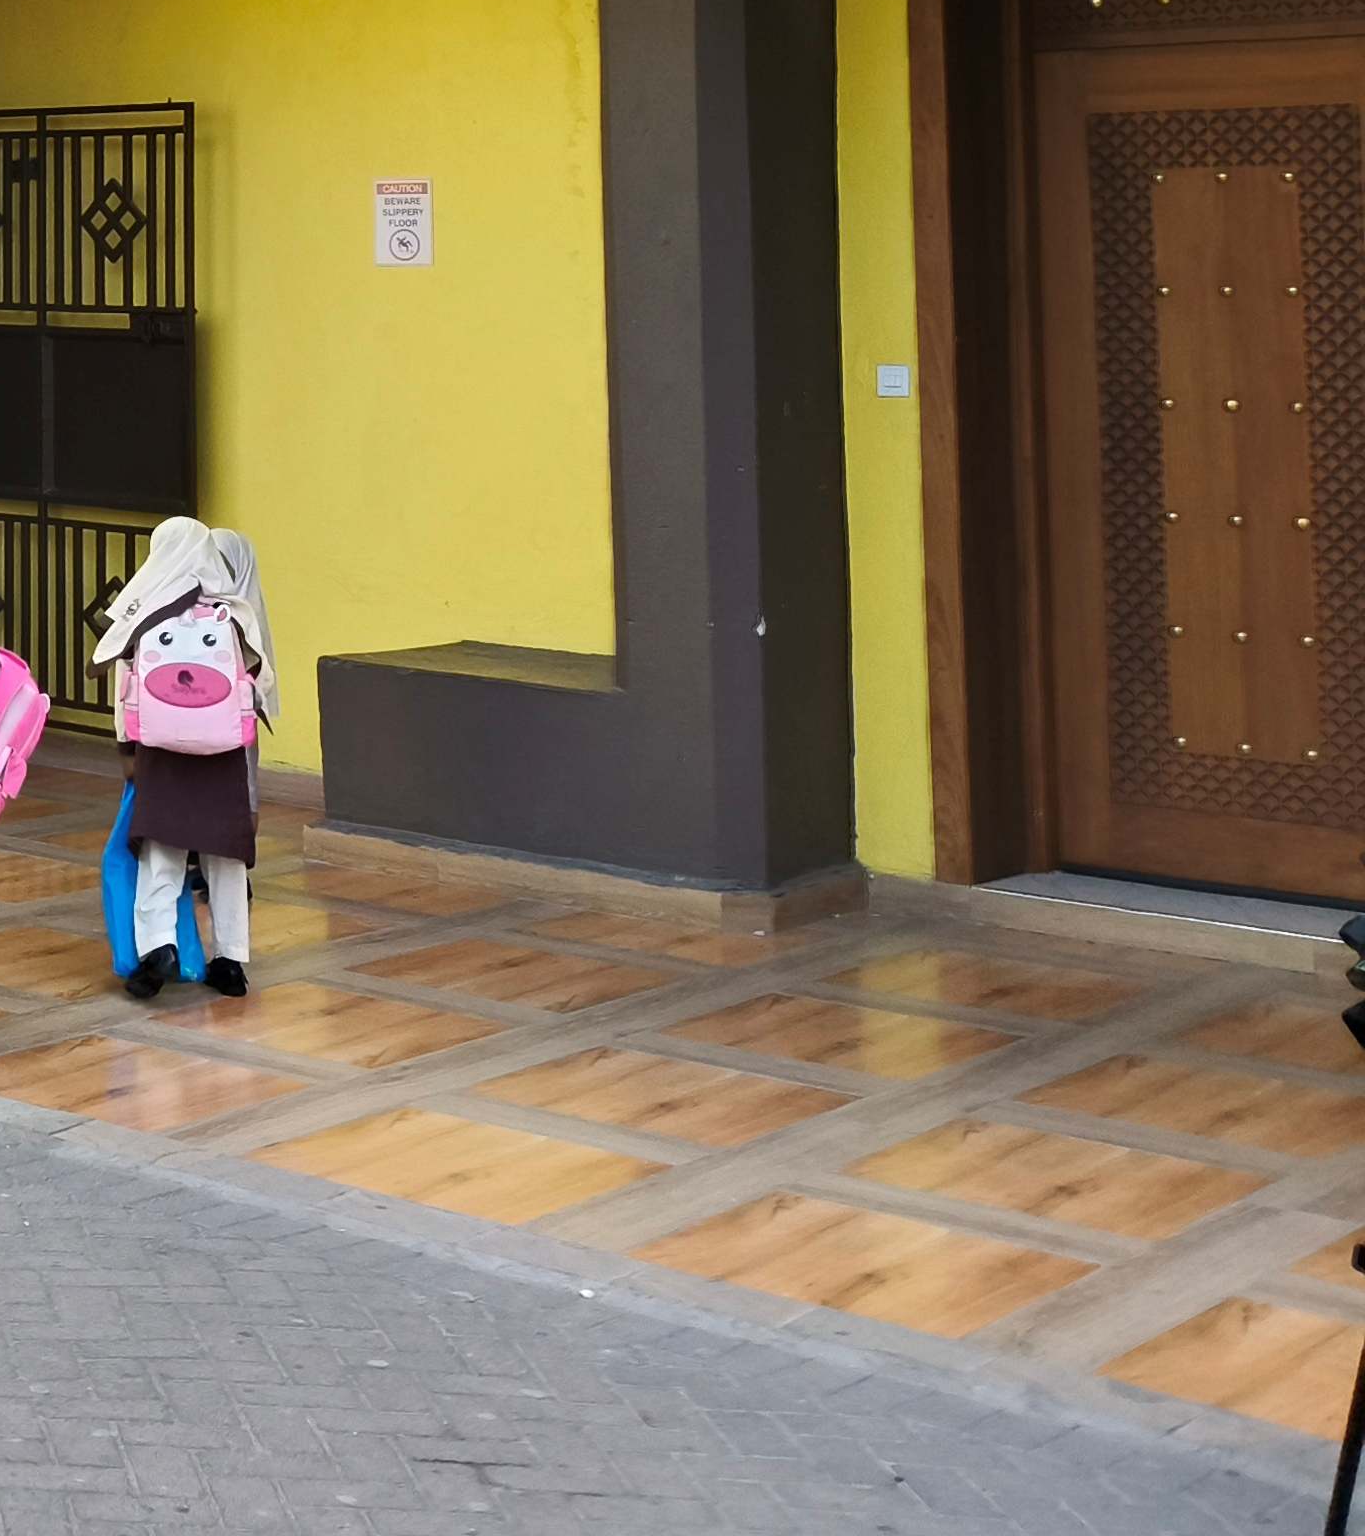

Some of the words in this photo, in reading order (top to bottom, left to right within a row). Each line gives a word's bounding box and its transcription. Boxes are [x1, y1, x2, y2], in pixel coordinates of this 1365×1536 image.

[382, 183, 423, 194] CAUTION
[384, 197, 422, 205] BEWARE
[382, 208, 424, 217] SLIPPERY
[388, 218, 418, 227] FLOOR
